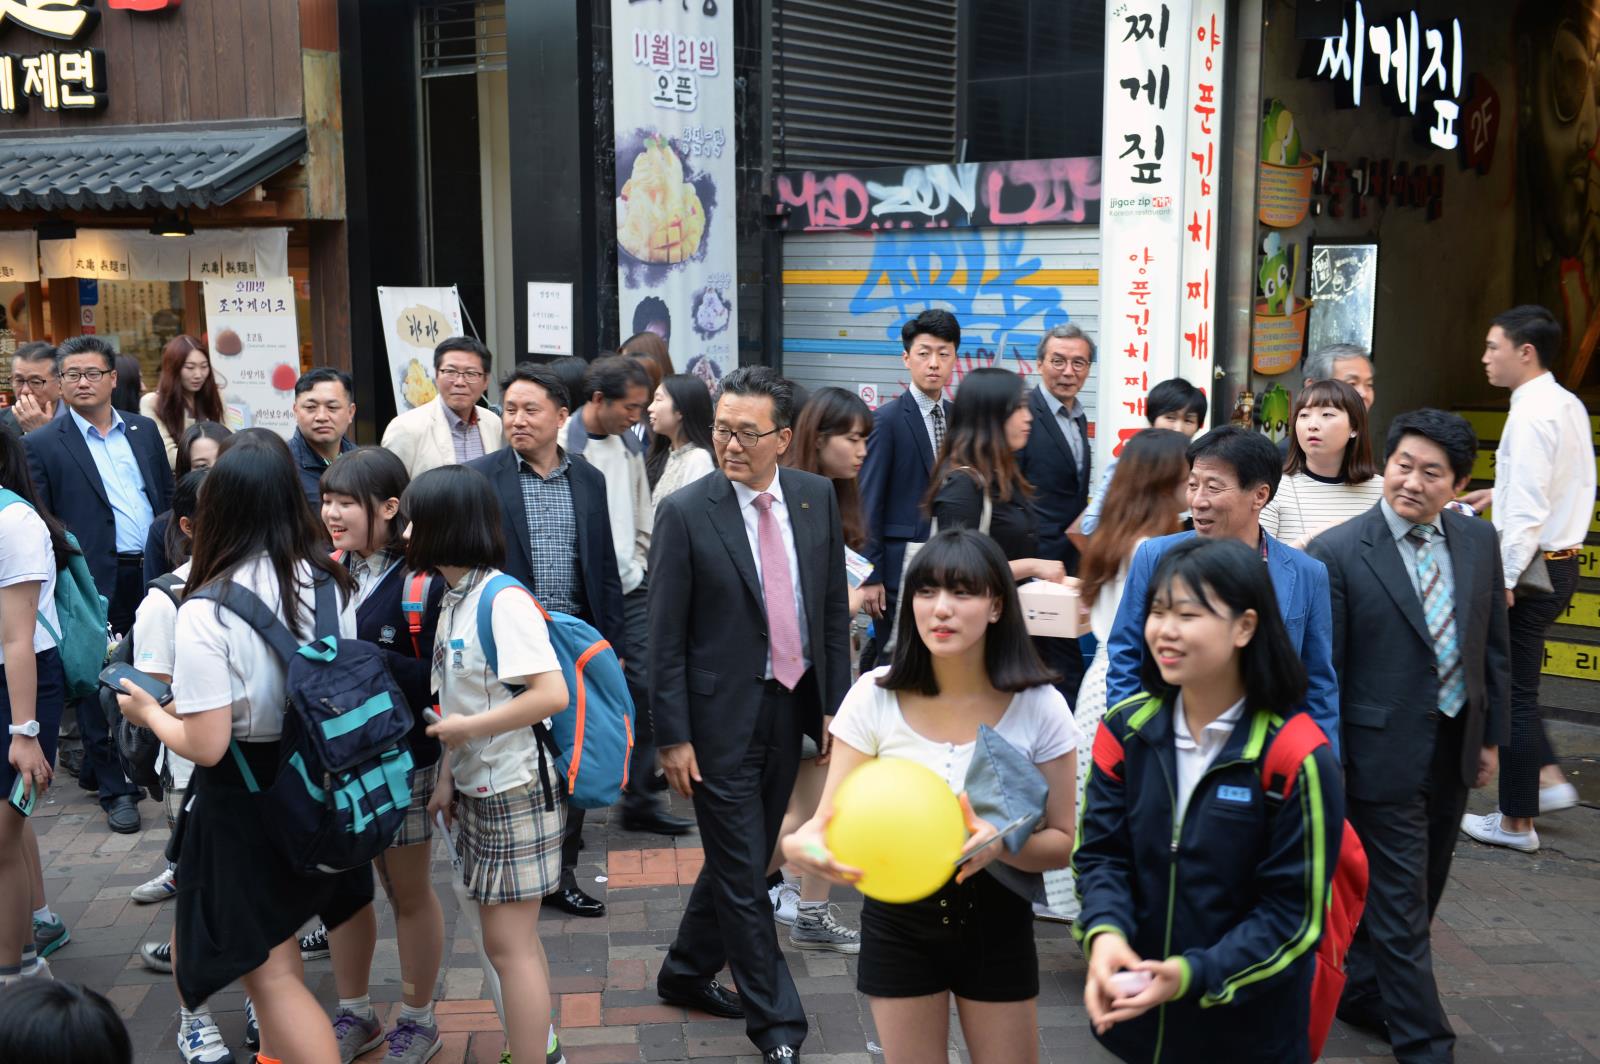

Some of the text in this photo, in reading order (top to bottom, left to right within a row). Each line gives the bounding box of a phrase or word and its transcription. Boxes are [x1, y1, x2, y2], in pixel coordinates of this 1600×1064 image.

[635, 33, 715, 71] 11월 21일
[23, 49, 96, 109] 제면
[654, 75, 692, 106] 오픈
[1470, 95, 1492, 153] 2F
[1138, 196, 1151, 208] zip
[1184, 13, 1221, 360] 양푼김치찌개
[218, 298, 286, 313] 조각케이크
[1122, 246, 1154, 417] 양푼김치찌개
